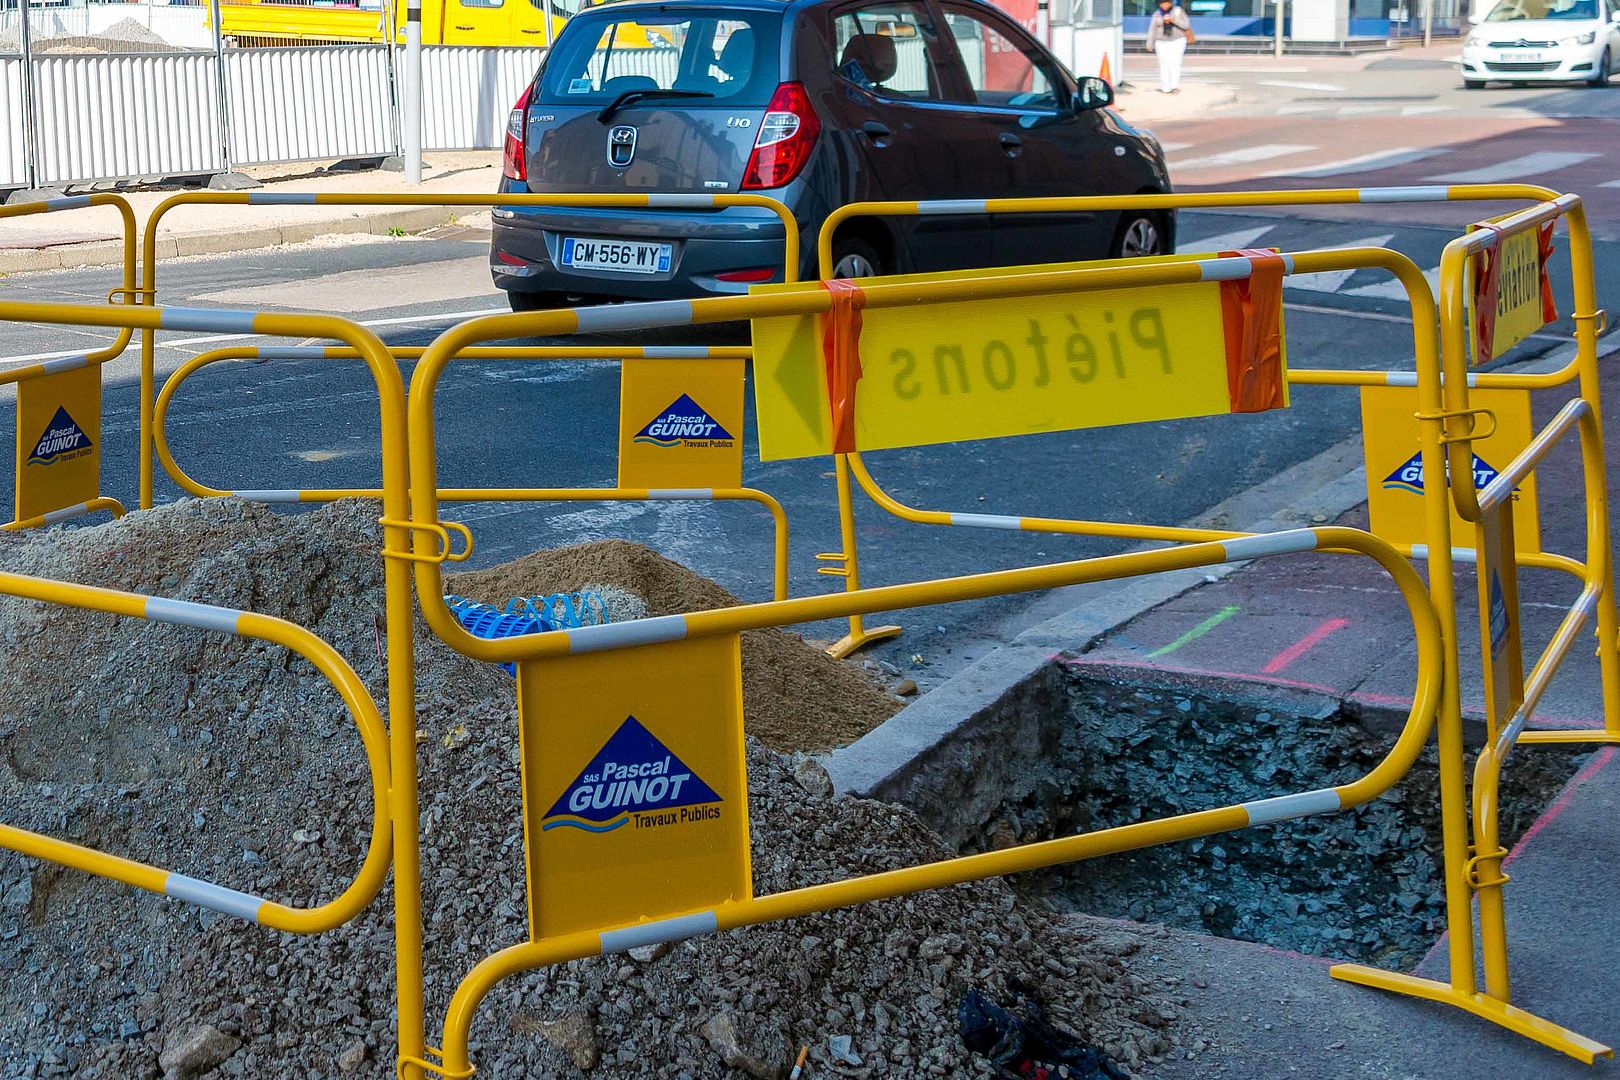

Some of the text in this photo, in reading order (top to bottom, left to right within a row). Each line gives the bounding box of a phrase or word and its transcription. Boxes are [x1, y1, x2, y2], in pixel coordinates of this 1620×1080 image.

[574, 243, 659, 266] CM-556-WY
[648, 423, 717, 436] GUINOT
[667, 414, 706, 424] Pascal
[49, 424, 76, 439] Pascal
[37, 432, 82, 456] GUINOT
[683, 440, 733, 448] Travaux Publics
[583, 755, 671, 784] SAS Pascal
[568, 773, 691, 812] GUINOT
[633, 805, 721, 830] Travaux Publics
